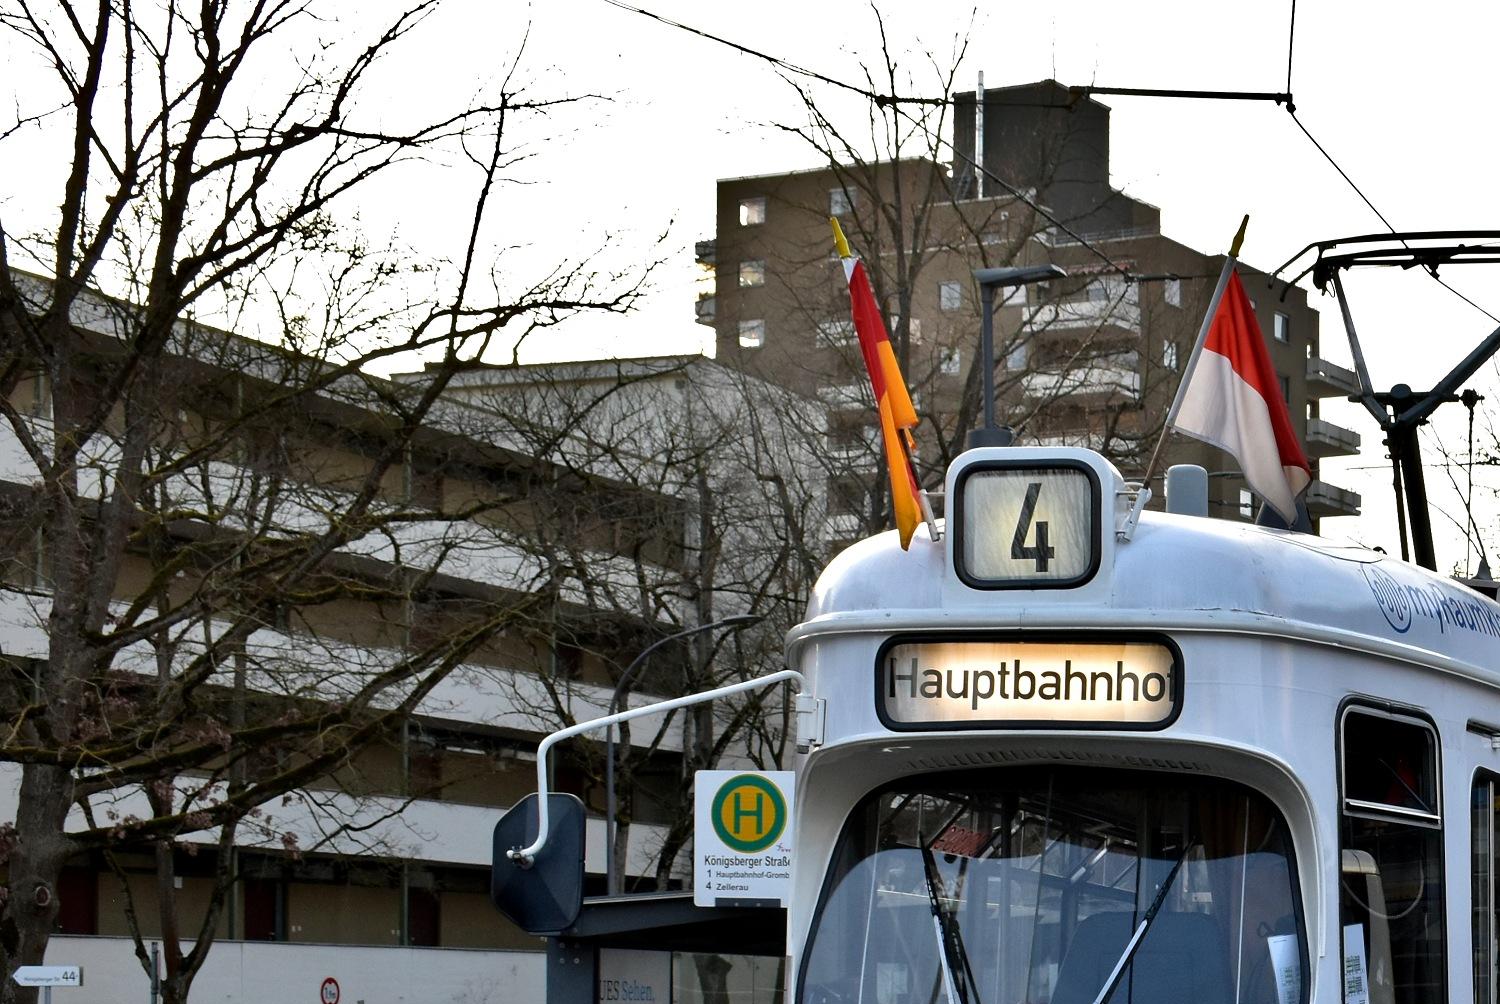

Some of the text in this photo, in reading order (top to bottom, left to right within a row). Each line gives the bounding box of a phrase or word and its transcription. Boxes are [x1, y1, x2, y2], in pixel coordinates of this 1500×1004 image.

[1010, 482, 1055, 573] 4
[704, 855, 762, 869] Königsberger
[715, 870, 790, 880] Hauptbahnhof-Gromb
[706, 881, 749, 891] 4 Zellerau
[600, 979, 656, 1003] UES Sehen,
